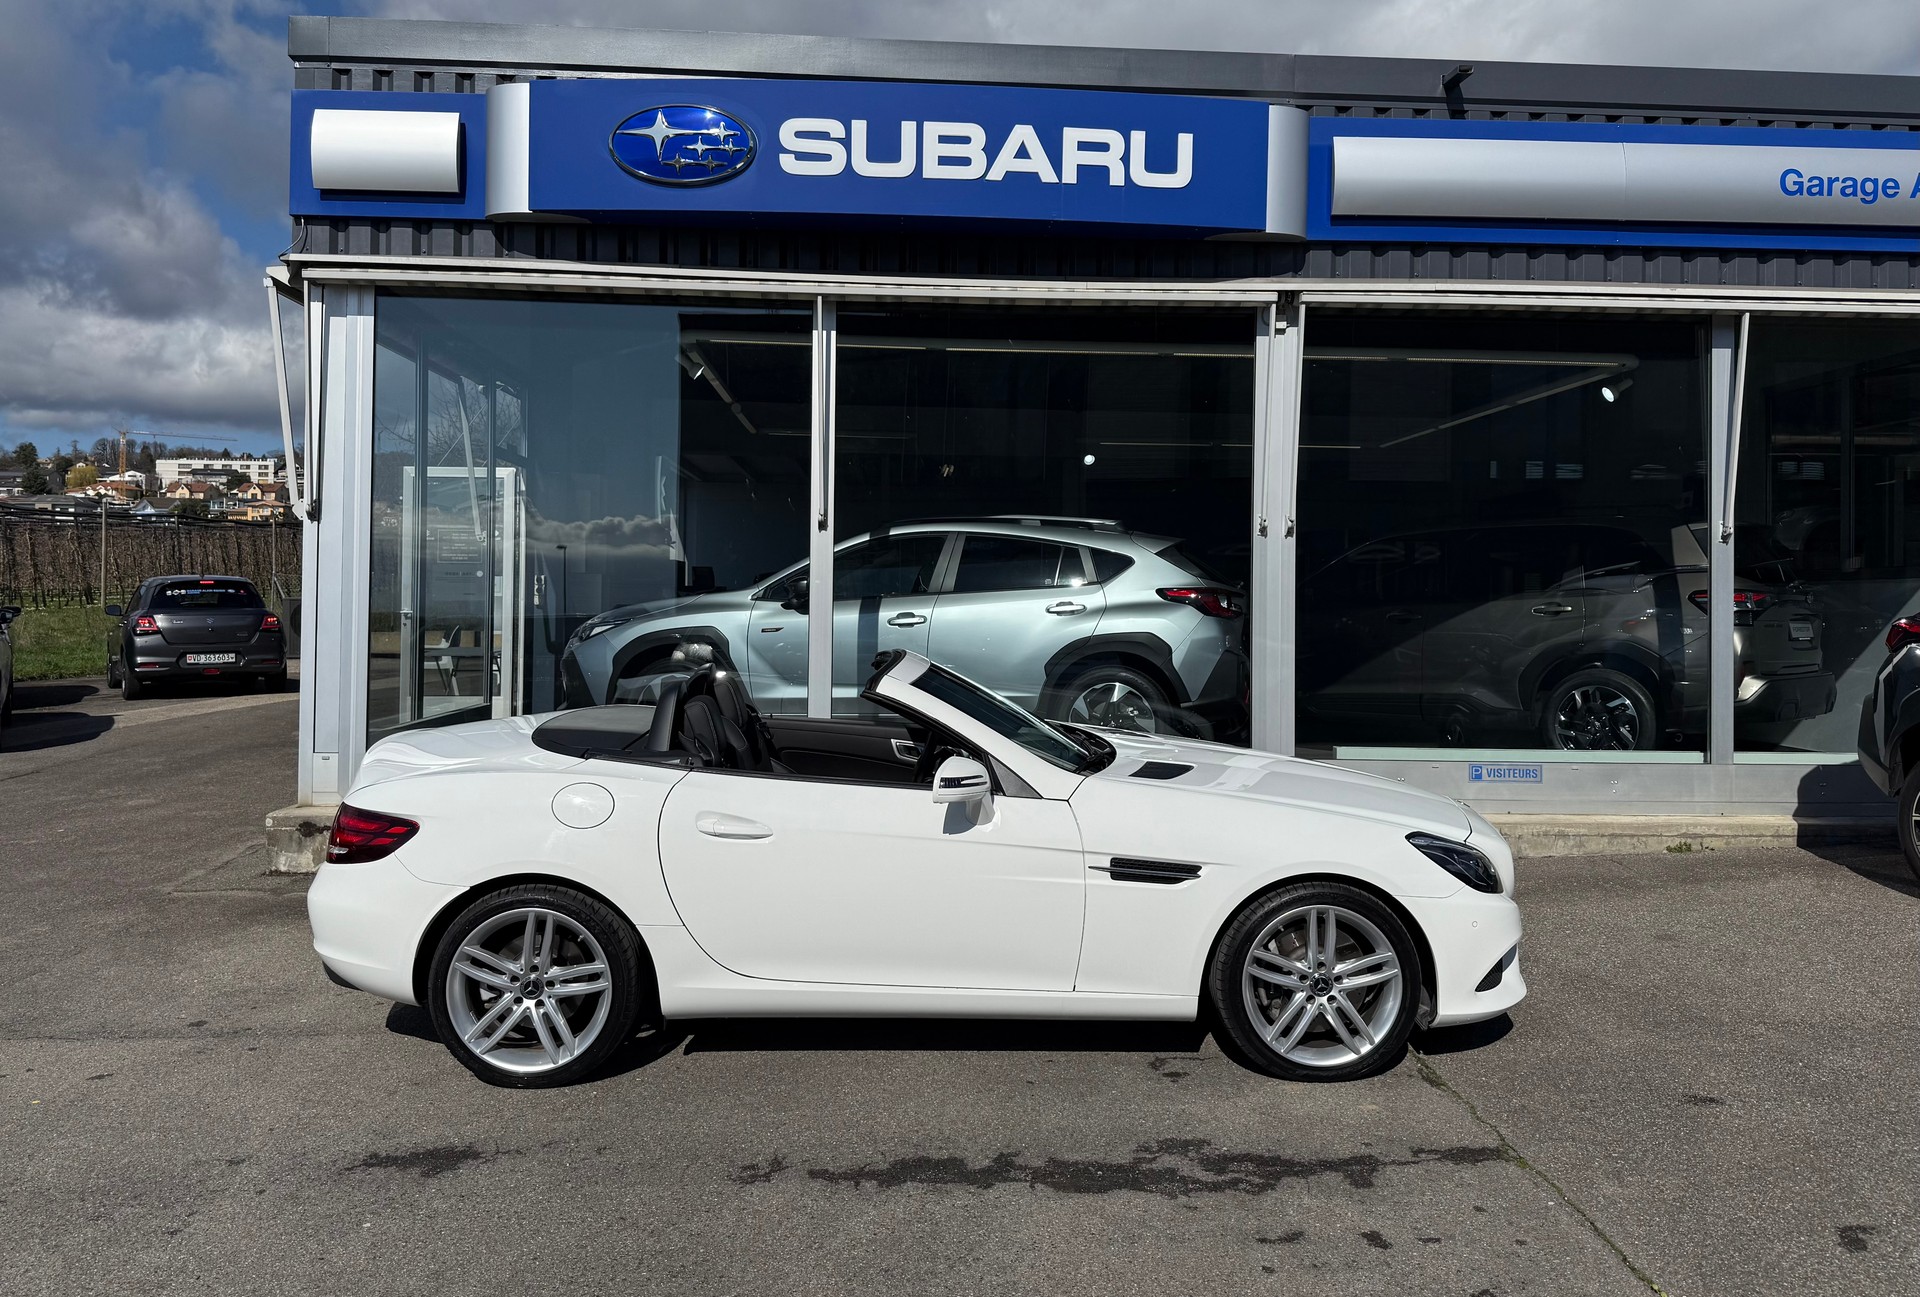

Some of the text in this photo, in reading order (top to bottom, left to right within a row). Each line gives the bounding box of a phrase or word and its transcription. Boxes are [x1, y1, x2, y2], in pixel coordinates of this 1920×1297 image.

[779, 117, 1194, 189] SUBARU
[1780, 168, 1900, 205] Garage
[192, 653, 230, 662] VD 363603
[1486, 768, 1538, 779] VISITEURS
